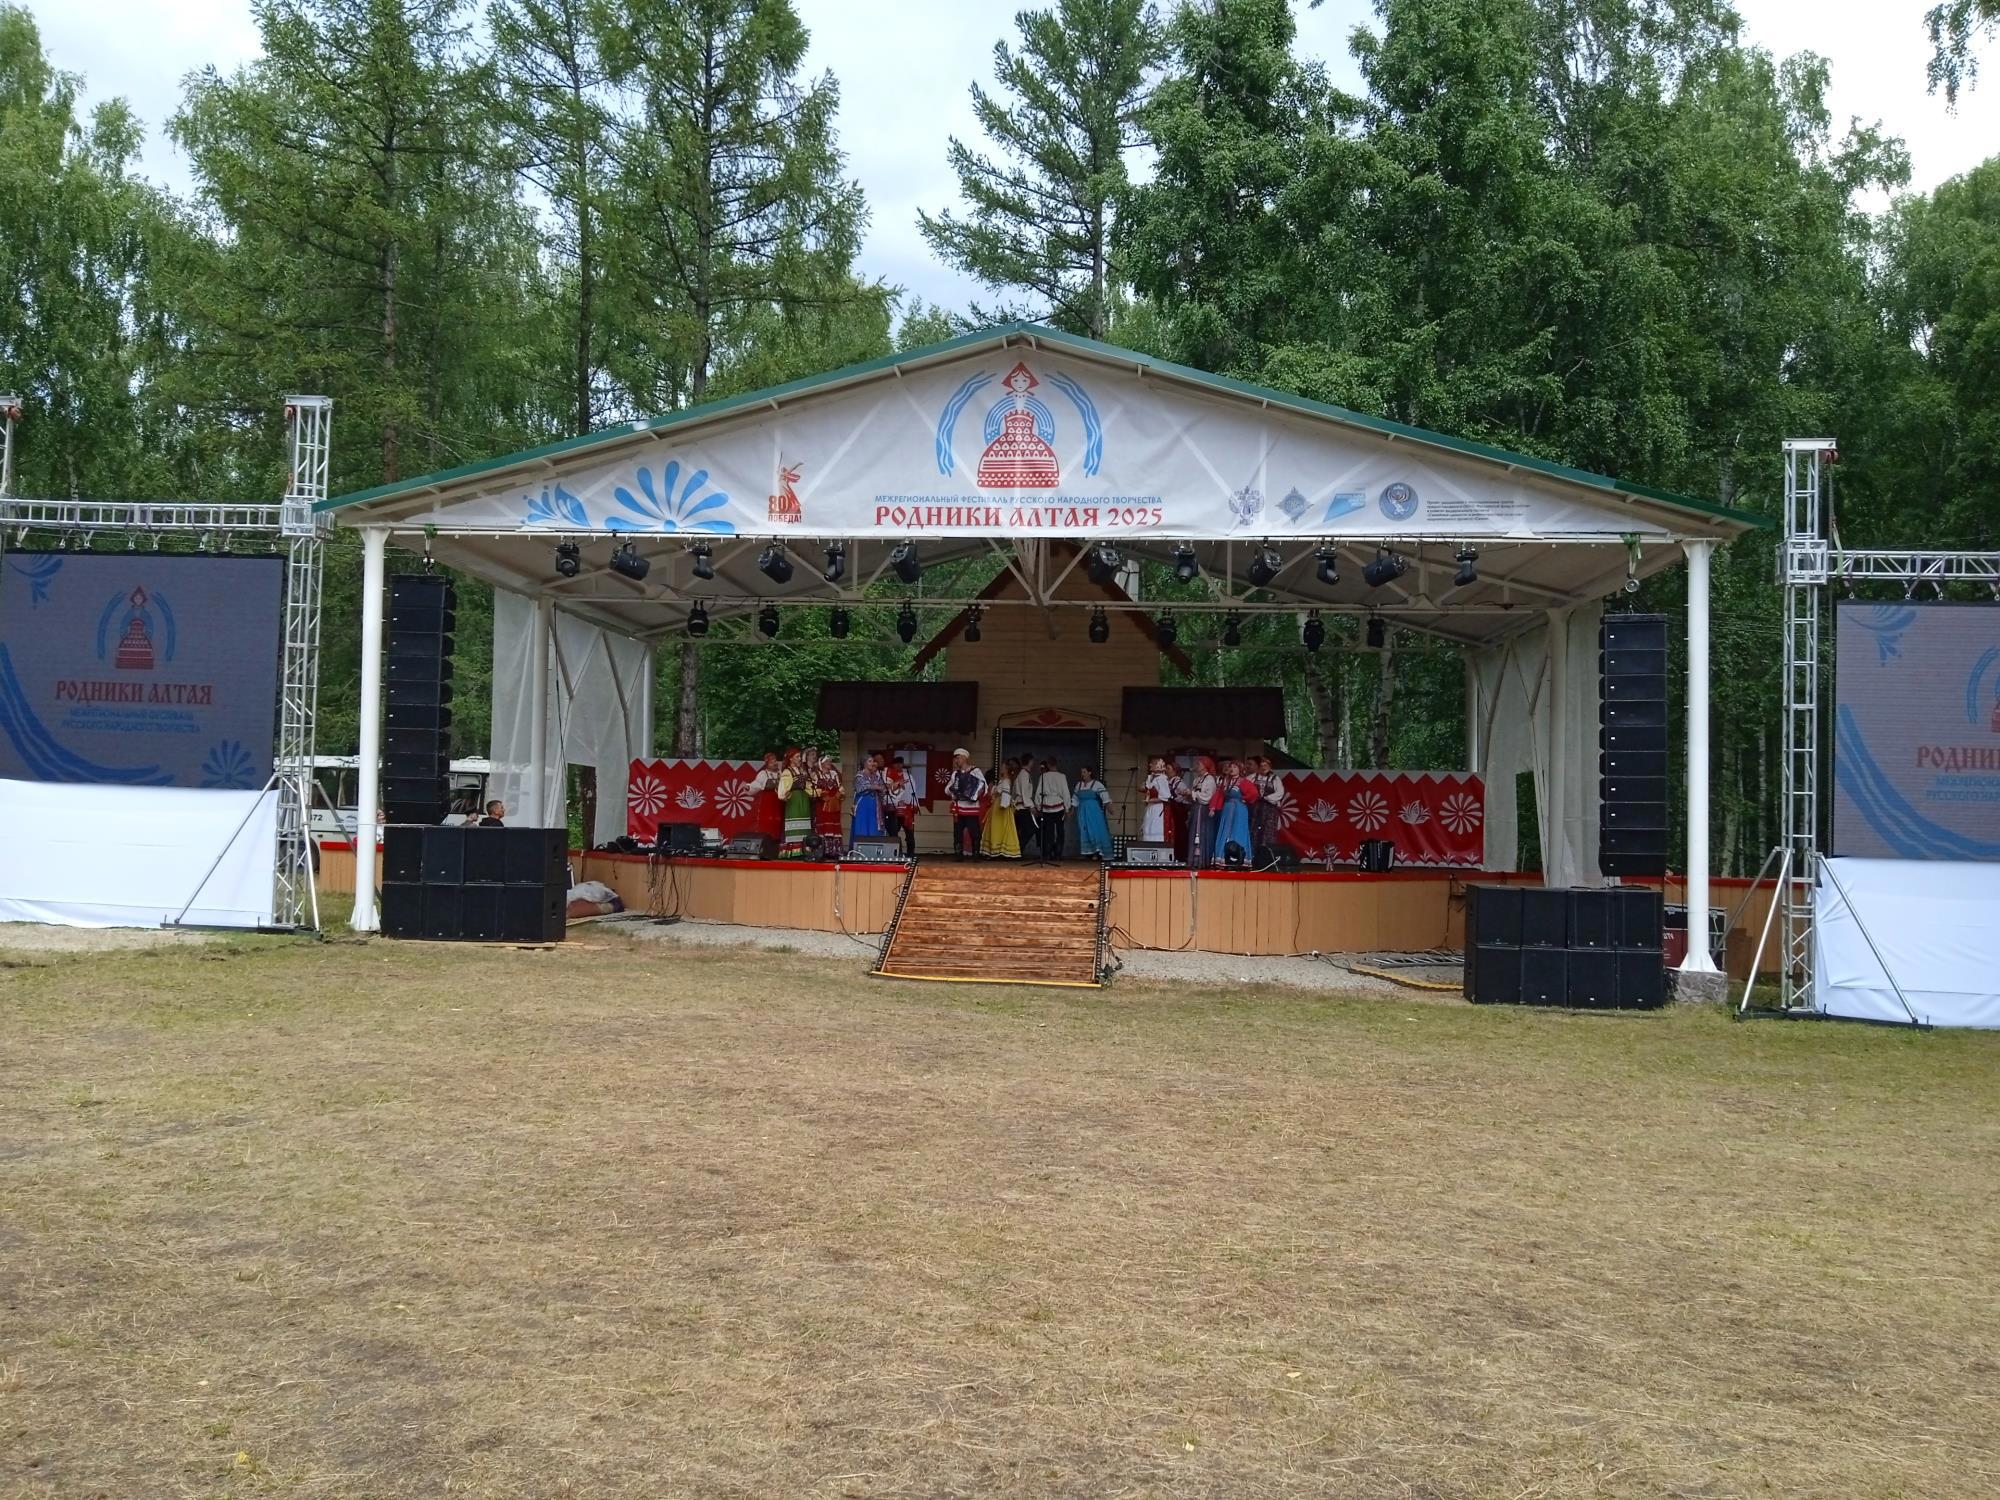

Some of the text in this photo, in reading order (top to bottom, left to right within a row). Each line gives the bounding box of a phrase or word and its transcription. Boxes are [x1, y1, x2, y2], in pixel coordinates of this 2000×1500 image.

[875, 494, 1162, 505] МЕЖРЕГИОНАЛЬНЫЙ ФЕСТИВАЛЬ РУССКОГО НАРОДНОГО ТВОРЧЕСТВА
[874, 506, 1163, 530] РОДНИКИ АЛТАЯ 2025
[55, 680, 213, 707] РОДНИКИ АЛТАЯ
[1915, 746, 2000, 773] РОДНИ
